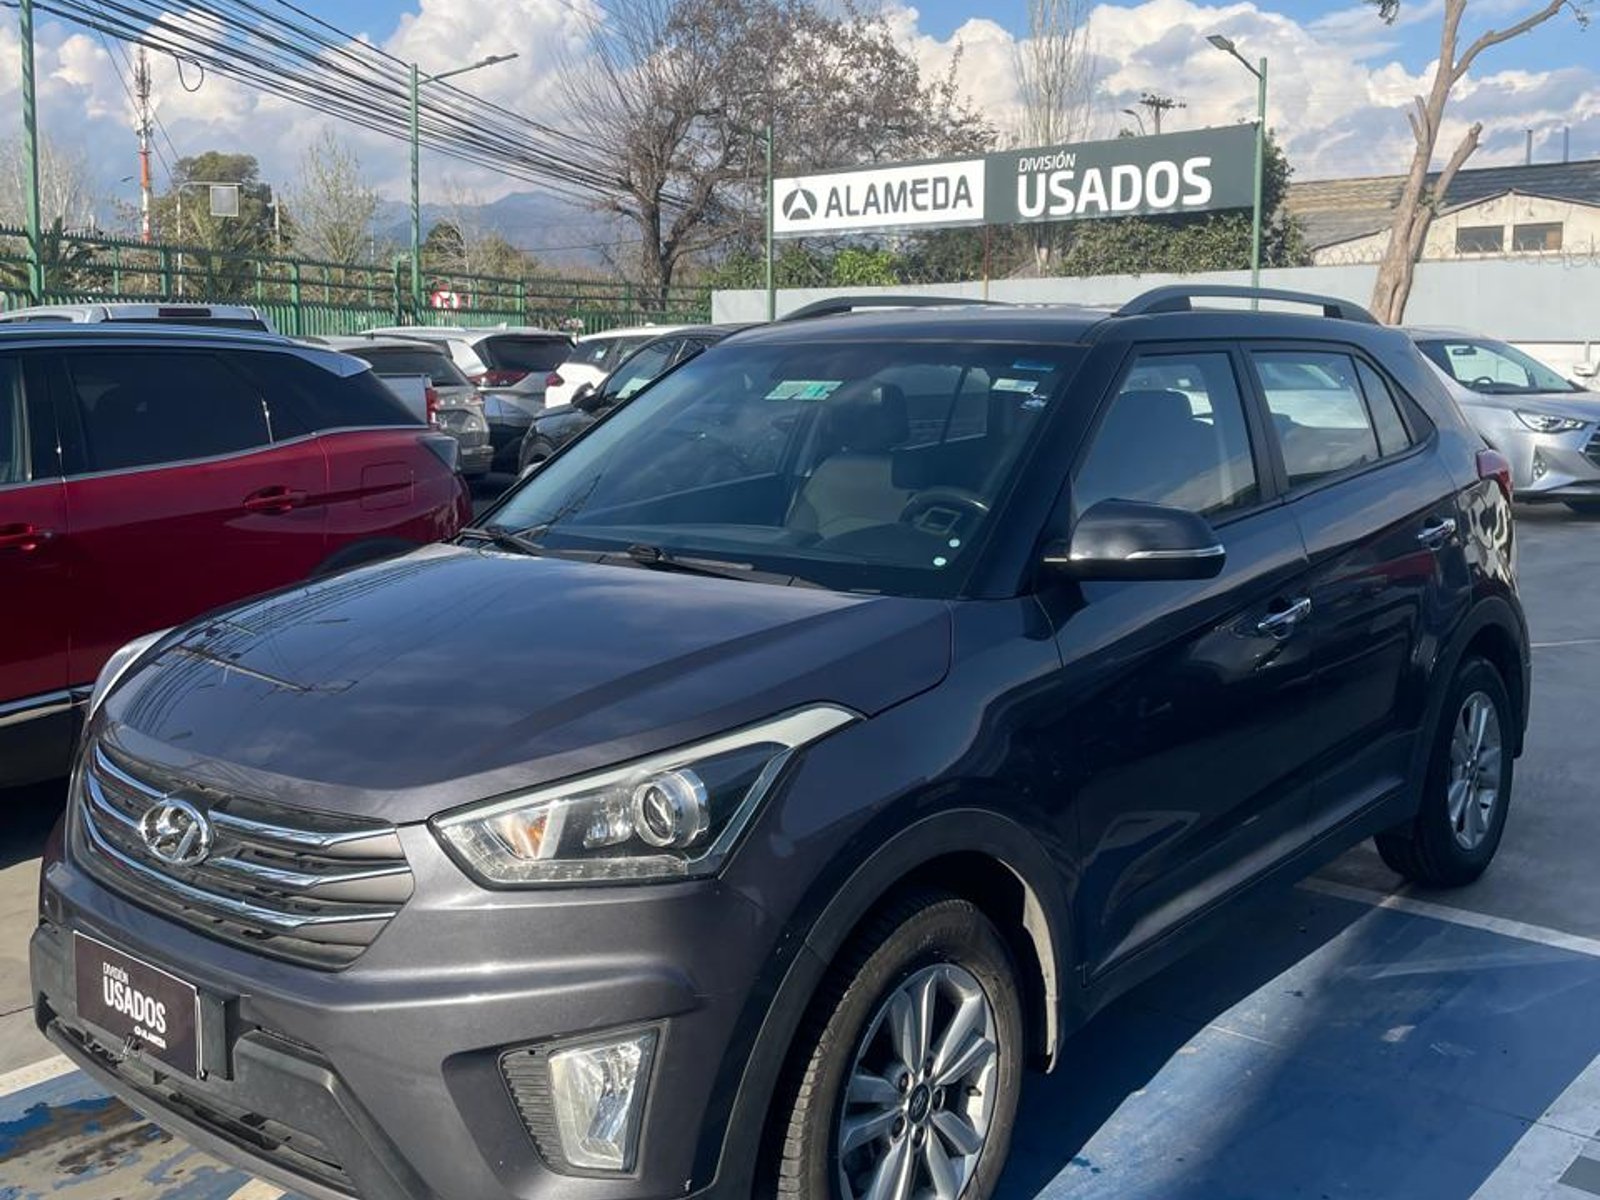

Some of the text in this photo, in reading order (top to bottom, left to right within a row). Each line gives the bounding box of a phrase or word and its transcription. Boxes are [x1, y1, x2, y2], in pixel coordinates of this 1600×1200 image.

[1017, 156, 1213, 218] USADOS
[1018, 151, 1076, 172] DIVISIÓN
[825, 174, 973, 218] ALAMEDA
[103, 975, 166, 1034] USADOS
